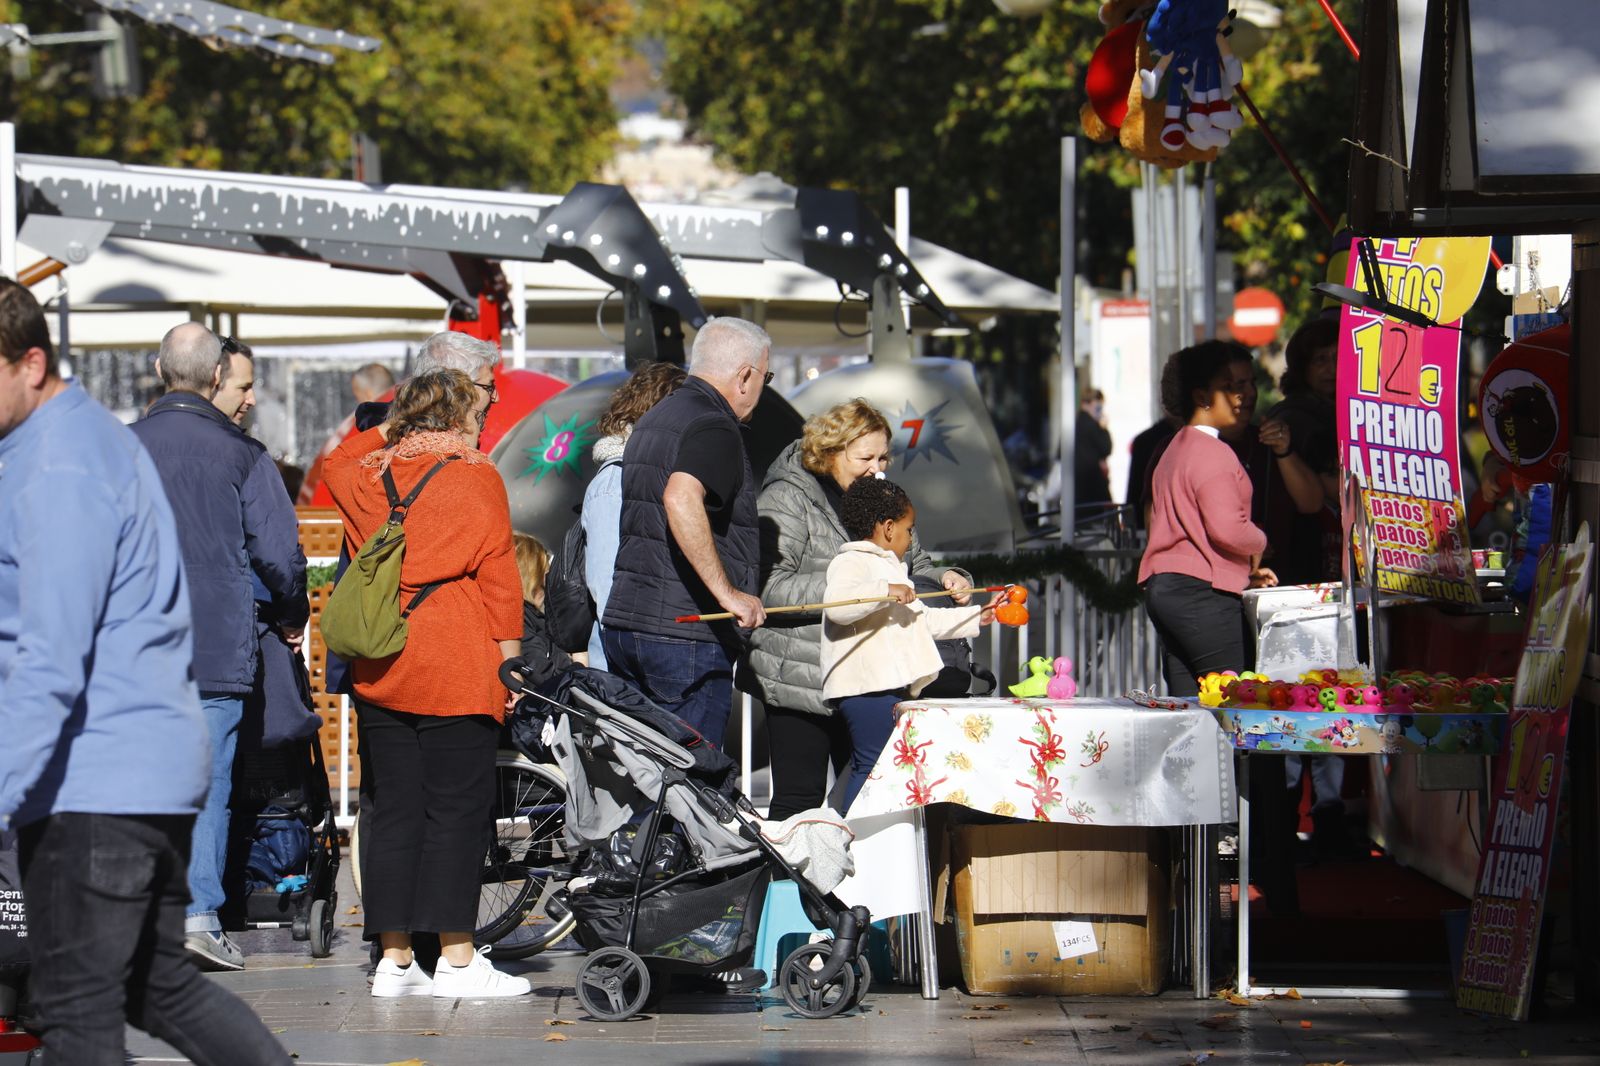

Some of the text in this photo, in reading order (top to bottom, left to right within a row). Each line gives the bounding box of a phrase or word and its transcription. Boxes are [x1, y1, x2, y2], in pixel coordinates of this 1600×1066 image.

[1351, 256, 1444, 322] TOS
[901, 419, 925, 449] 7
[1350, 398, 1443, 454] PREMIO
[543, 431, 575, 463] 8
[1350, 445, 1454, 502] A ELEGIR
[1370, 497, 1424, 522] patos
[1375, 523, 1429, 549] patos
[1380, 547, 1434, 573] patos
[1377, 569, 1480, 606] EMPRE TOCA
[1491, 799, 1548, 849] PREMIO
[1478, 849, 1543, 901] A ELEGIR
[1484, 904, 1518, 929] patos
[1480, 931, 1513, 958] patos
[1476, 960, 1507, 985] patos
